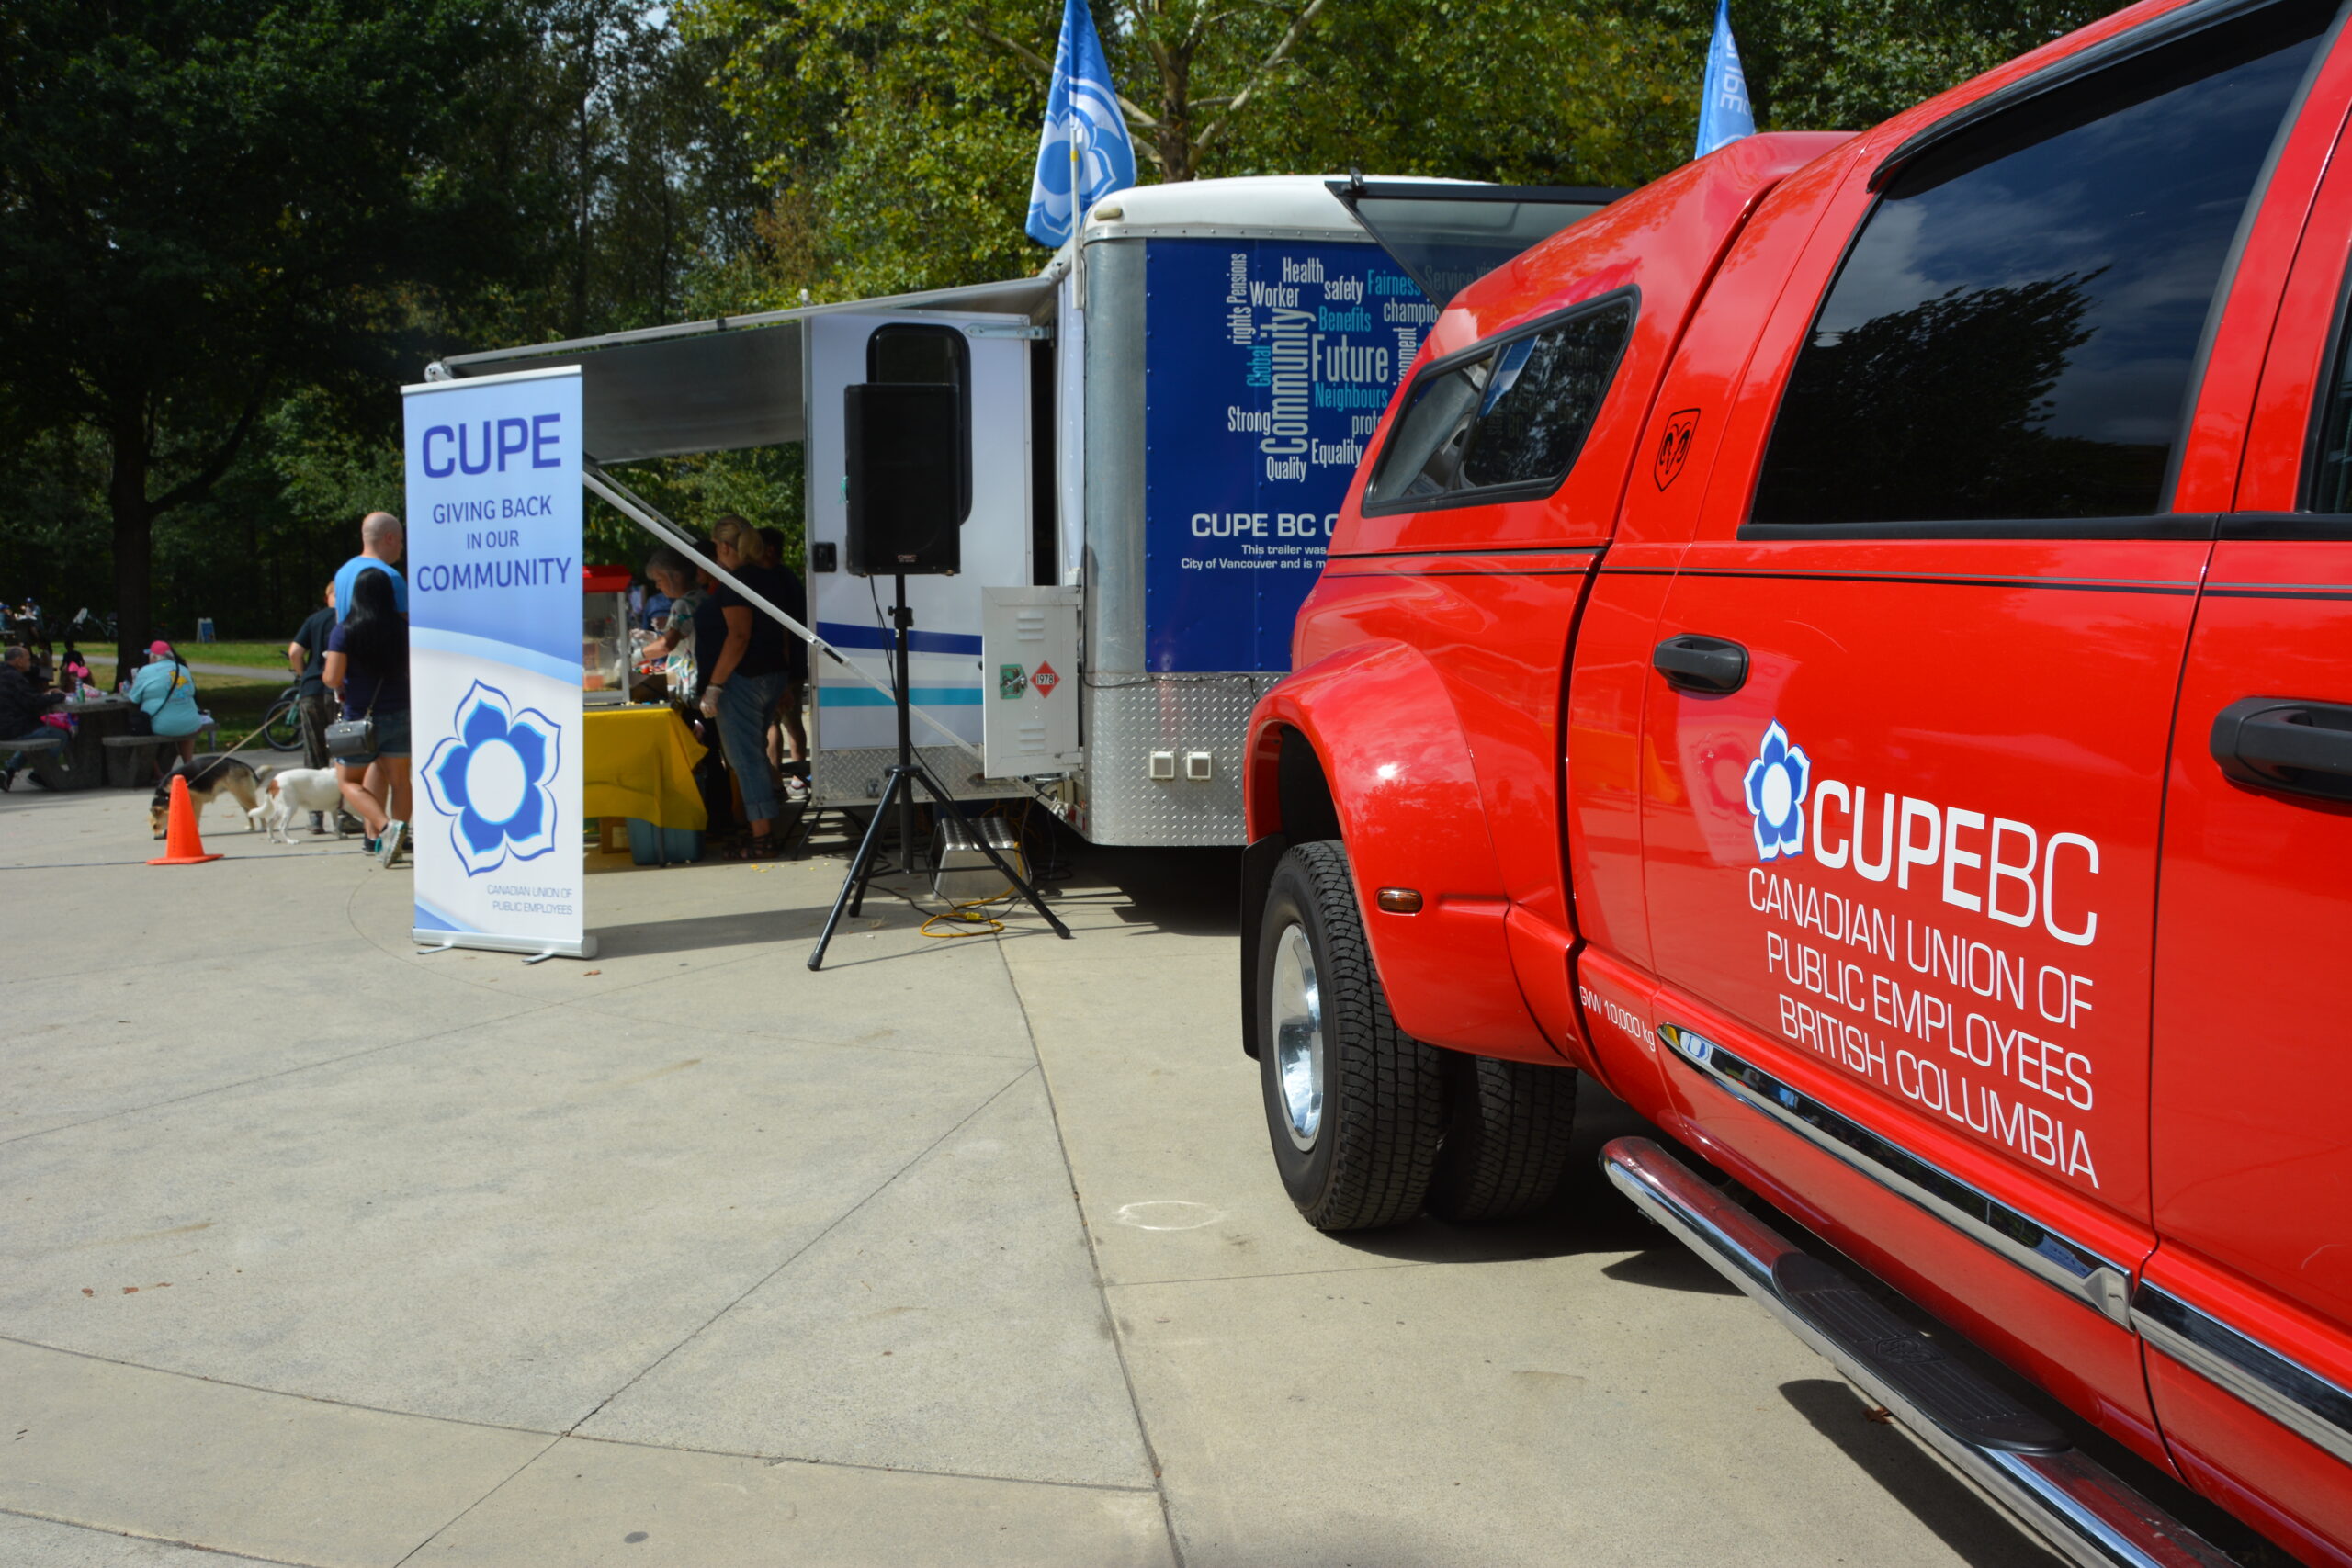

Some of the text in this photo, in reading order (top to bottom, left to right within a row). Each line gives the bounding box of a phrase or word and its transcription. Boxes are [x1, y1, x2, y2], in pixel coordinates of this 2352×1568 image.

[1227, 254, 1247, 303] Pensions
[1283, 256, 1324, 284] Health
[1367, 269, 1421, 296] Fairness
[1250, 281, 1300, 308] Worker
[1324, 276, 1363, 305] safety
[1227, 307, 1256, 344] rights
[1318, 305, 1372, 332] Benefits
[1384, 298, 1442, 326] champio
[1246, 345, 1271, 387] Global
[1312, 333, 1389, 383] Future
[1260, 308, 1317, 454] Community
[1315, 382, 1388, 412] Neighbours
[1227, 406, 1271, 436] Strong
[423, 413, 561, 478] CUPE
[1312, 438, 1363, 468] Equality
[1266, 456, 1307, 483] Quality
[433, 495, 552, 524] GIVING BACK
[467, 530, 519, 549] IN OUR
[1191, 513, 1269, 537] CUPE
[1277, 513, 1317, 537] BC
[1241, 544, 1327, 555] This trailer was
[417, 557, 571, 592] COMMUNITY
[1181, 558, 1203, 571] City
[1205, 558, 1217, 569] of
[1219, 558, 1278, 569] Vancouver
[1280, 558, 1301, 569] and
[1303, 558, 1313, 569] is
[1036, 674, 1054, 684] 1978
[487, 884, 572, 899] CANADIAN UNION OF
[492, 900, 573, 915] PUBLIC EMPLOYEES
[1748, 868, 2093, 1029] CANADIAN UNION OF
[1604, 1000, 1641, 1038] 10,000
[1642, 1021, 1656, 1052] kg
[1767, 931, 2093, 1111] PUBLIC EMPLOYEES
[1779, 993, 2099, 1189] BRITISH COLUMBIA
